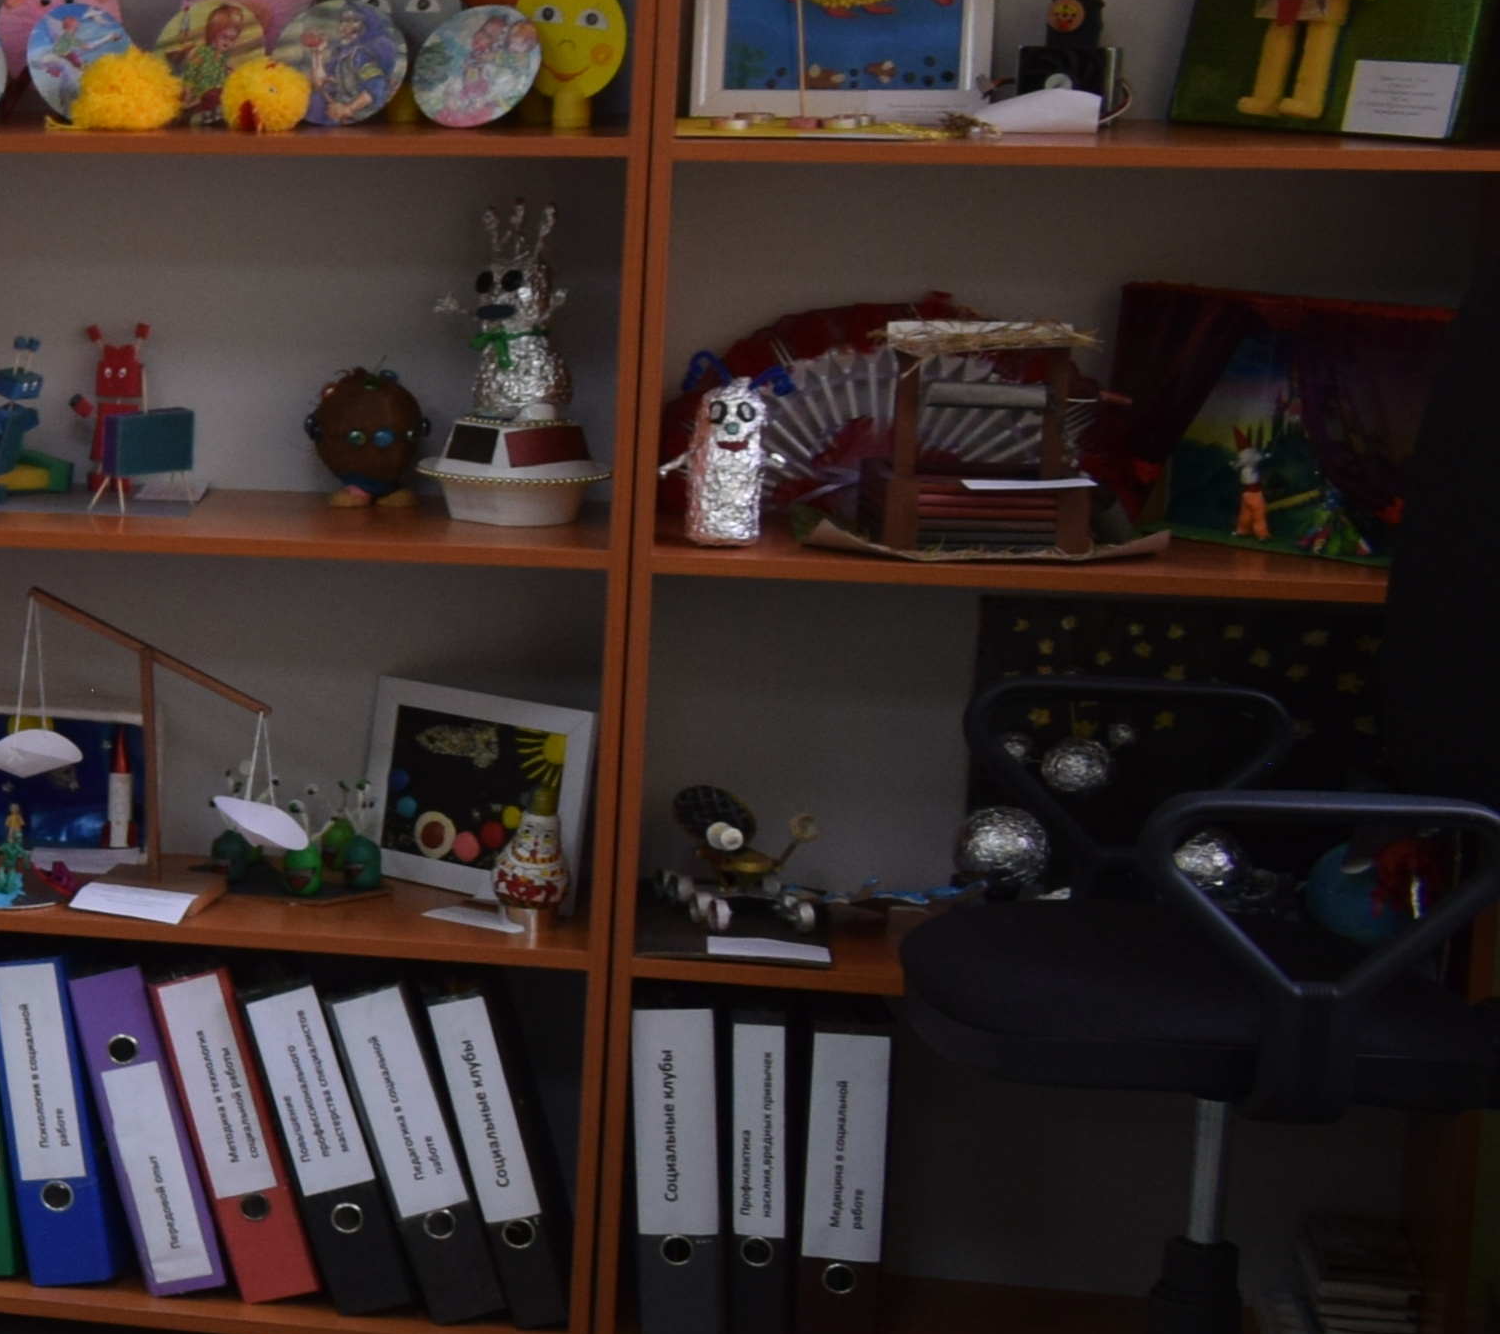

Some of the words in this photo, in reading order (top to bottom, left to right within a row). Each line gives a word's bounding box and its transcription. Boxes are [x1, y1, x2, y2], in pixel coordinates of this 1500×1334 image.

[19, 1002, 40, 1074] социальной
[195, 1029, 224, 1094] технология
[220, 1046, 244, 1091] работы
[296, 1008, 329, 1088] специалистов
[366, 1035, 400, 1105] социальной
[460, 1039, 487, 1089] клубы
[286, 1044, 332, 1159] профессионального
[657, 1049, 678, 1100] клубы
[763, 1051, 775, 1112] привычек
[31, 1081, 50, 1149] Психология
[55, 1107, 71, 1148] работе
[218, 1108, 241, 1164] Методика
[235, 1093, 260, 1160] социальной
[283, 1095, 312, 1164] Повышение
[320, 1087, 350, 1154] мастерства
[397, 1113, 425, 1181] Педагогика
[473, 1091, 511, 1189] Социальные
[834, 1080, 850, 1154] социальной
[149, 1154, 164, 1183] опыт
[662, 1102, 681, 1203] Социальные
[739, 1129, 752, 1217] Профилактика
[157, 1184, 182, 1250] Передовой
[828, 1163, 845, 1230] Медицина
[852, 1188, 865, 1231] работе
